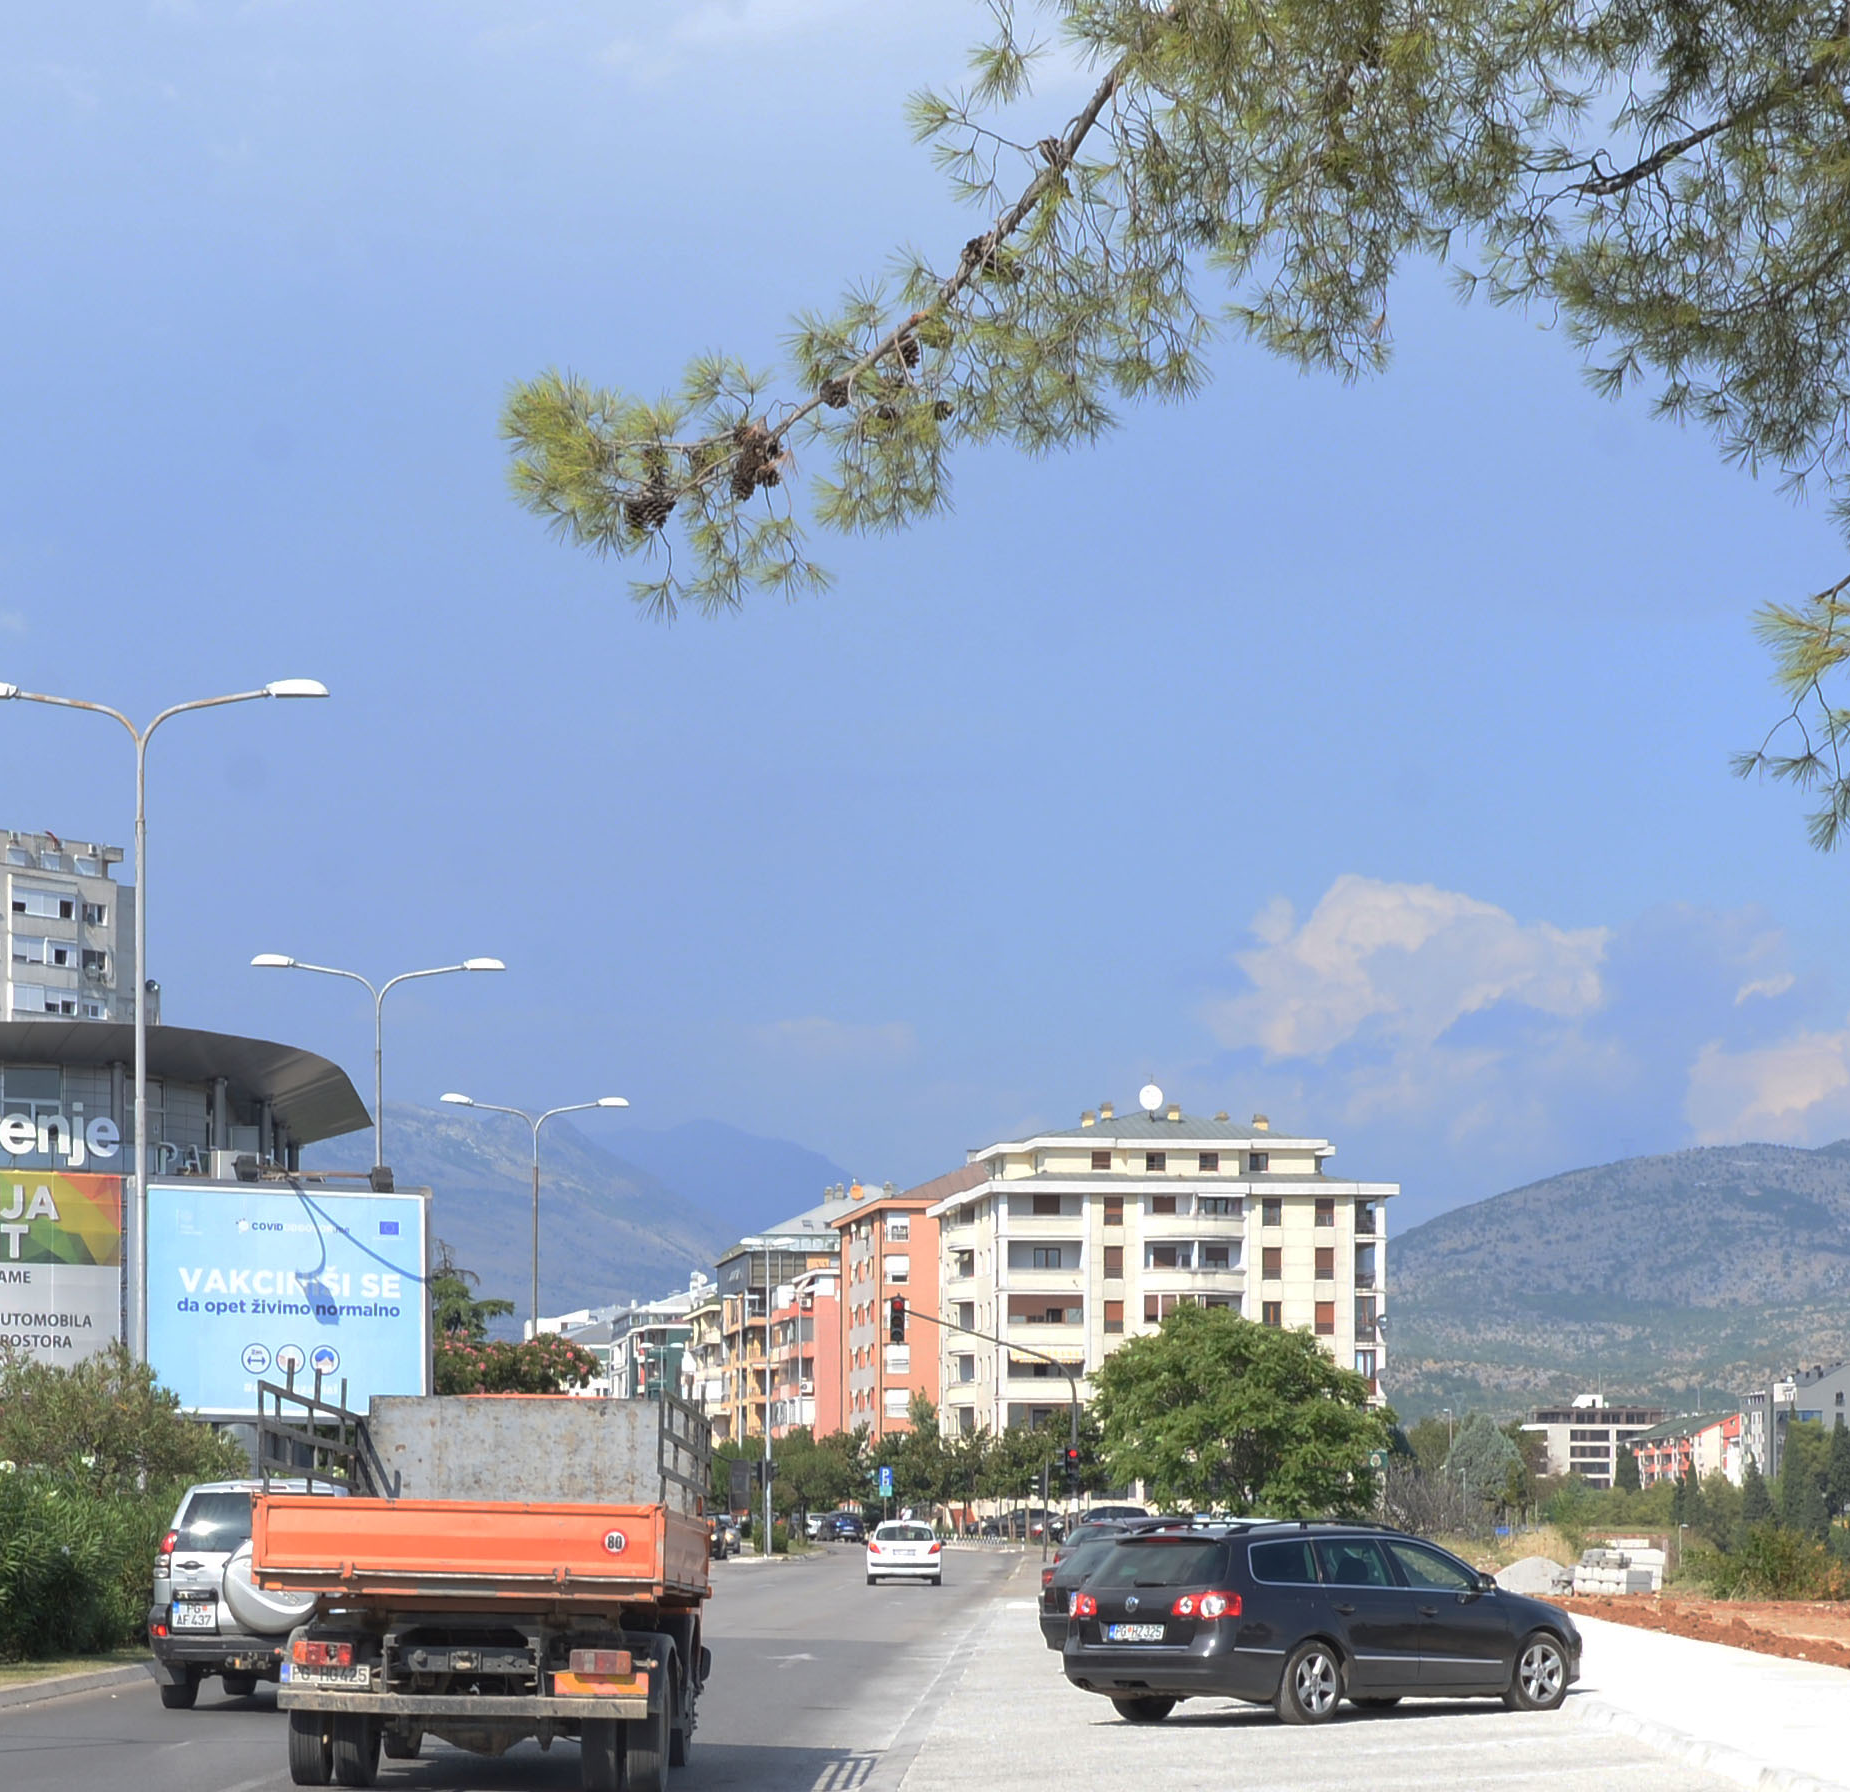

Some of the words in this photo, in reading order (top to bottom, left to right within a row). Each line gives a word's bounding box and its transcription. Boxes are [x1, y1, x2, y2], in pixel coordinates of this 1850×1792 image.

[360, 1272, 402, 1299] SE
[177, 1297, 200, 1313] da
[204, 1299, 246, 1316] opet
[251, 1299, 310, 1316] živimo
[316, 1302, 401, 1318] normalno
[607, 1535, 623, 1549] 80
[186, 1602, 202, 1614] PG
[176, 1614, 190, 1626] AF
[191, 1614, 212, 1626] 437
[292, 1665, 311, 1682] PG
